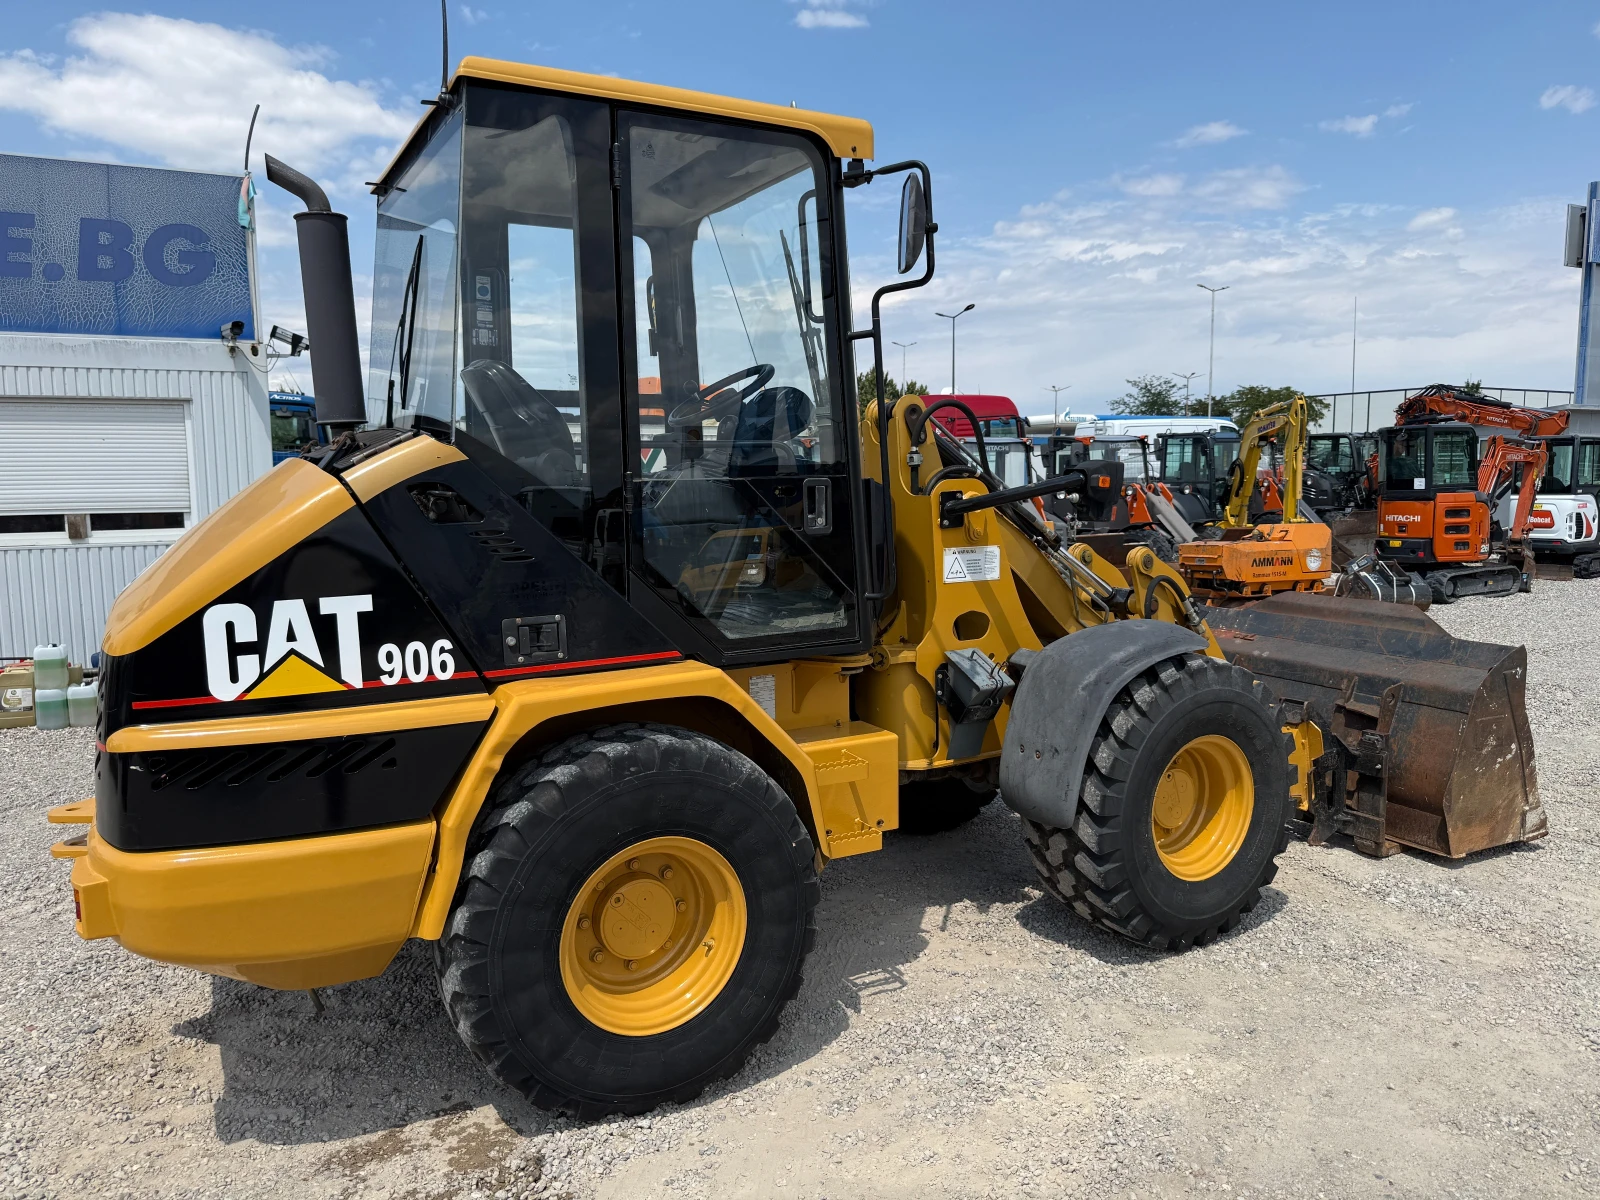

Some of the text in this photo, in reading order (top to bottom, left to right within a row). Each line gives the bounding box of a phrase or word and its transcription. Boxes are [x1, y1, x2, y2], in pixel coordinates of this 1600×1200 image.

[0, 211, 216, 287] E.BG
[1385, 514, 1421, 522] HITACHI
[1530, 516, 1551, 524] Bobcat
[1279, 530, 1289, 540] 7
[1251, 556, 1293, 567] AMMANN
[202, 594, 456, 702] CAT 906
